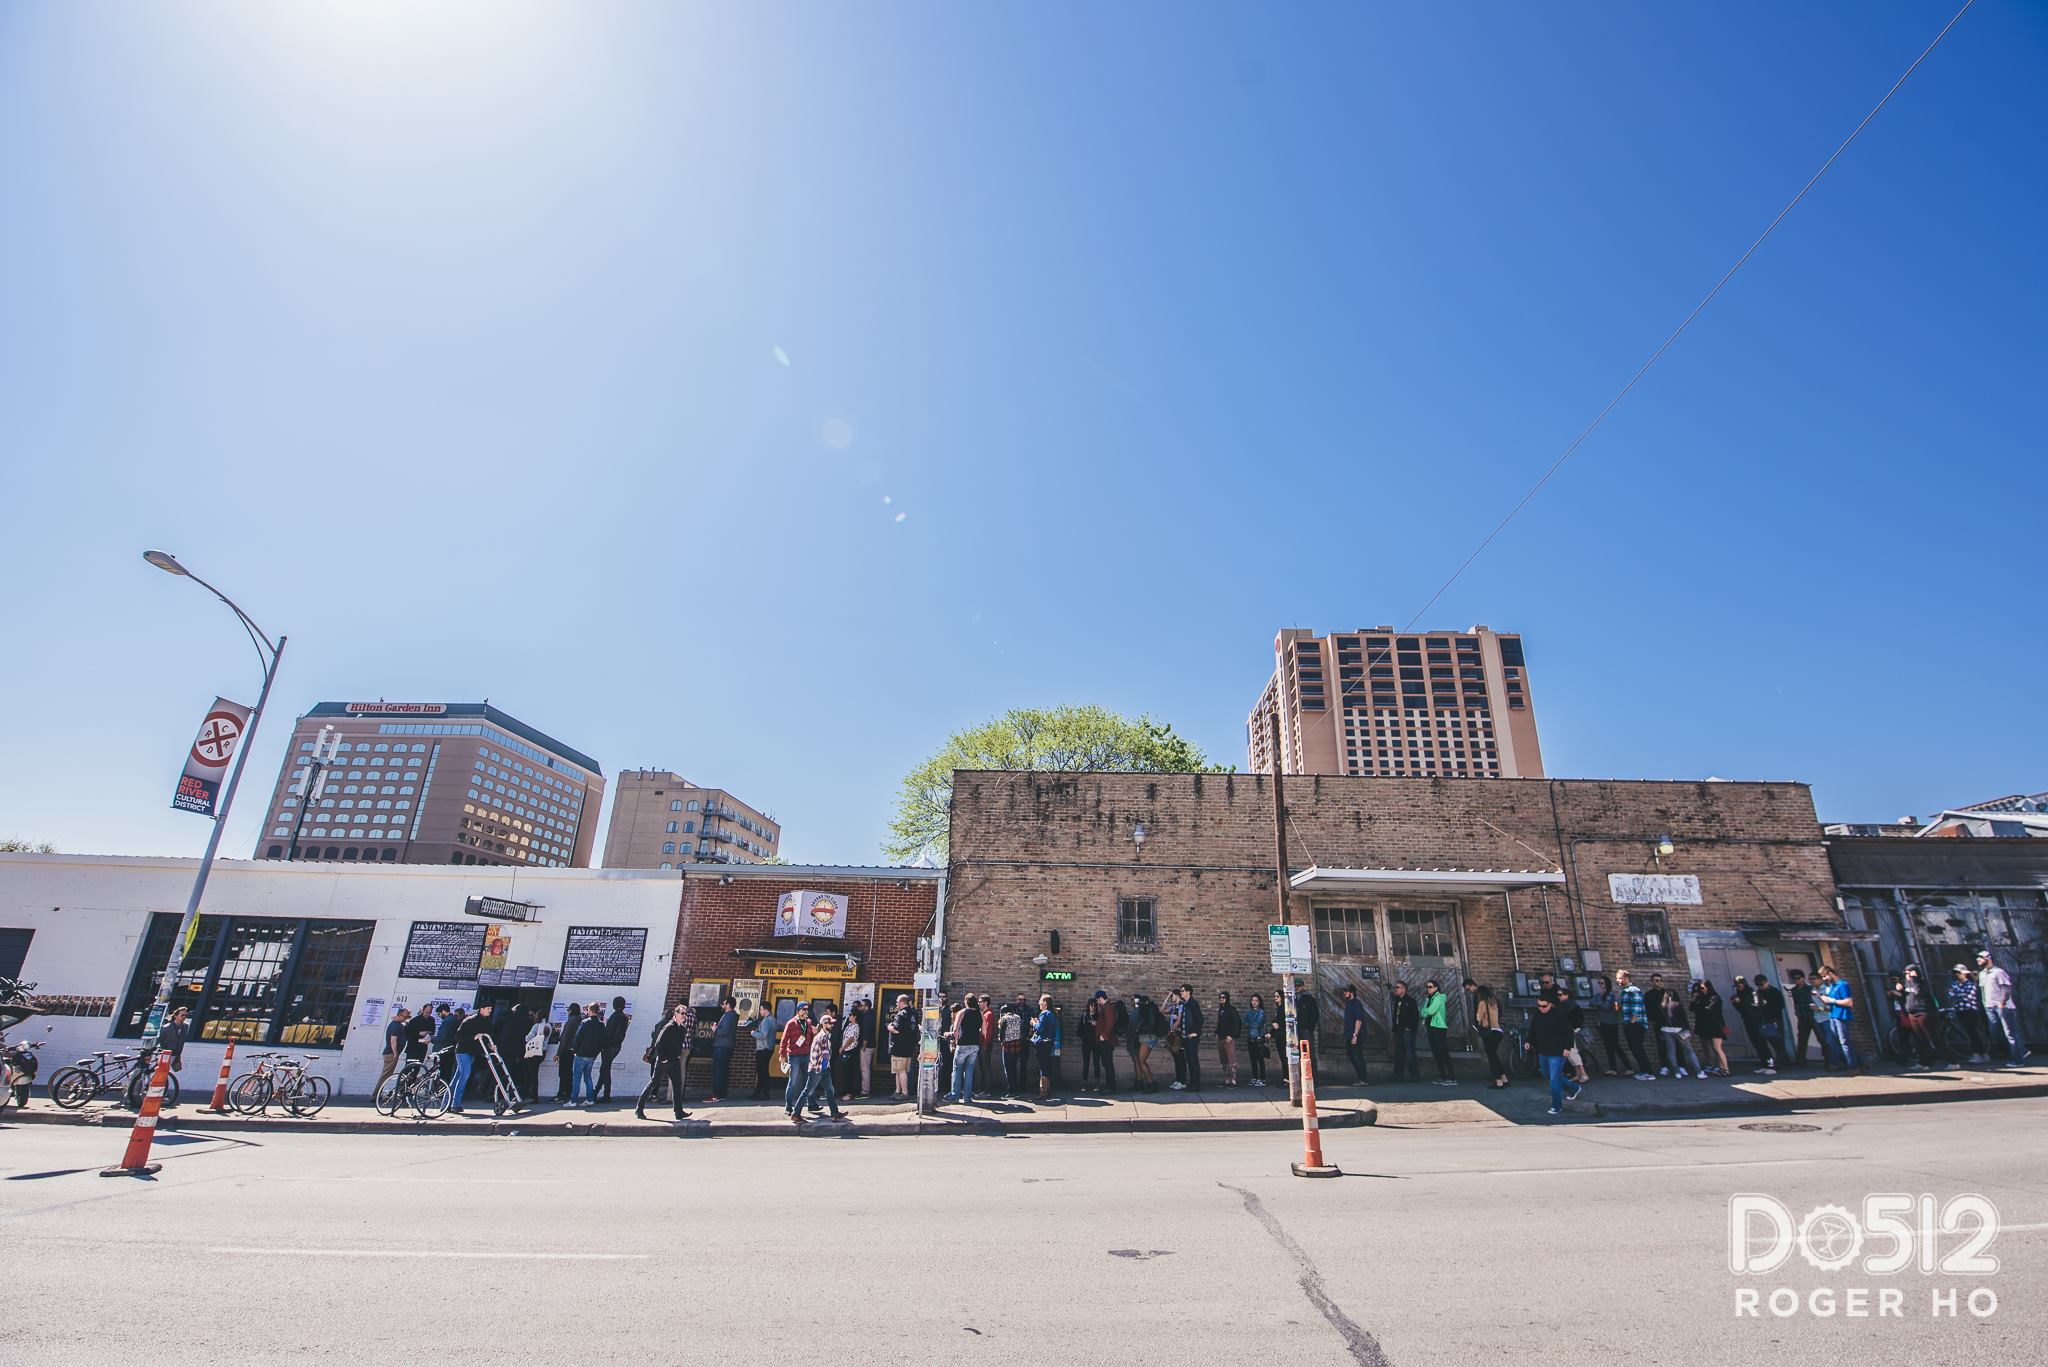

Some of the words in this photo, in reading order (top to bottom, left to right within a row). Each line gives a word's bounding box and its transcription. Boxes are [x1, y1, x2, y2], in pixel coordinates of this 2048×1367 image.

[350, 704, 382, 712] Hilton
[384, 704, 420, 712] Garden
[422, 704, 441, 712] Inn
[204, 730, 212, 738] R
[207, 746, 214, 754] D
[180, 776, 202, 788] RED
[178, 786, 209, 800] RIVER
[175, 800, 206, 812] DISTRICT
[176, 794, 210, 807] CULTURAL
[811, 894, 824, 907] AROUND
[806, 927, 836, 936] 476-JAIL
